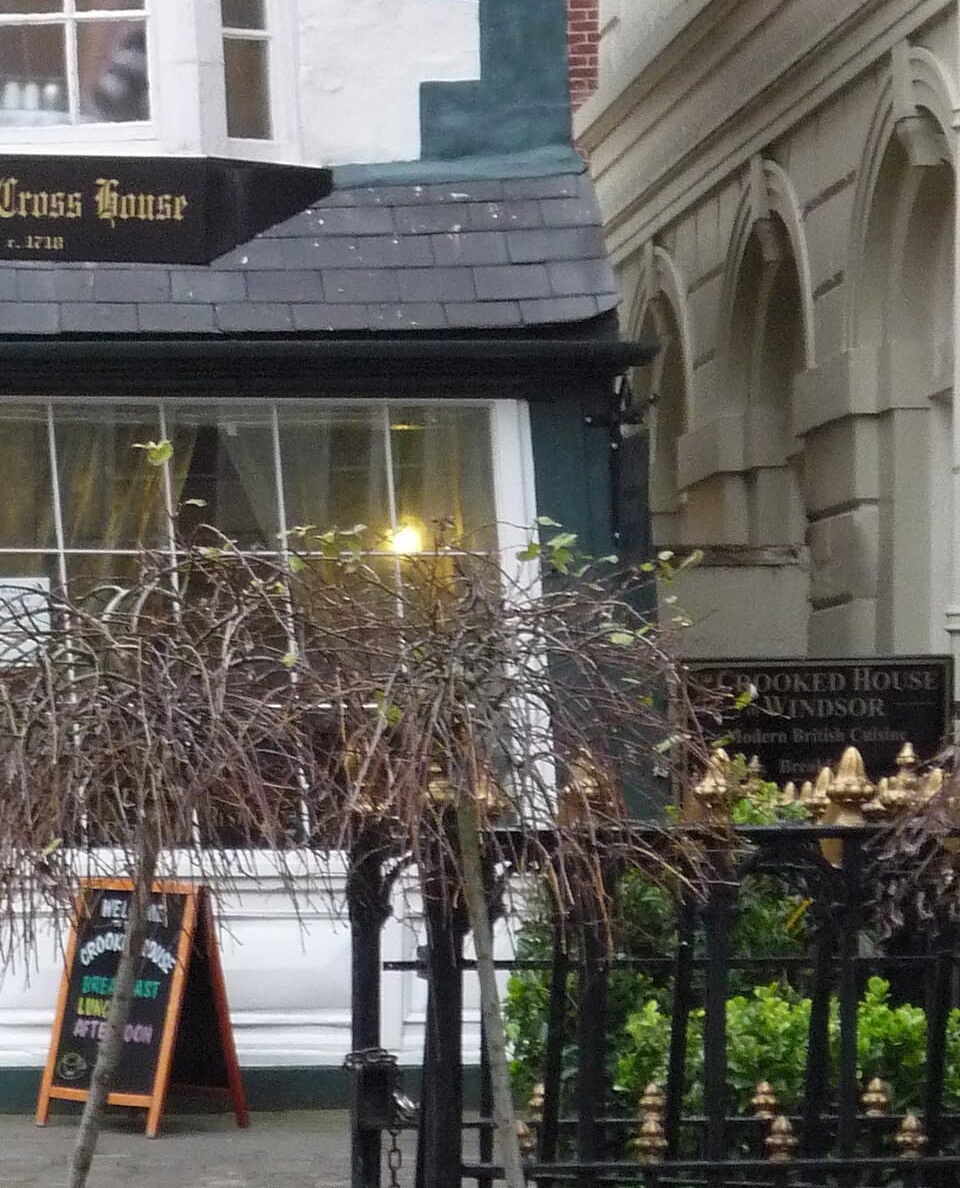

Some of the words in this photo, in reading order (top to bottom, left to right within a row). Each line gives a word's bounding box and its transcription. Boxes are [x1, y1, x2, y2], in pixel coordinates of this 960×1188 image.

[95, 178, 188, 229] House
[25, 235, 64, 250] 1718
[854, 667, 939, 692] HOUSE
[763, 696, 886, 718] WINDSOR
[792, 728, 846, 744] British
